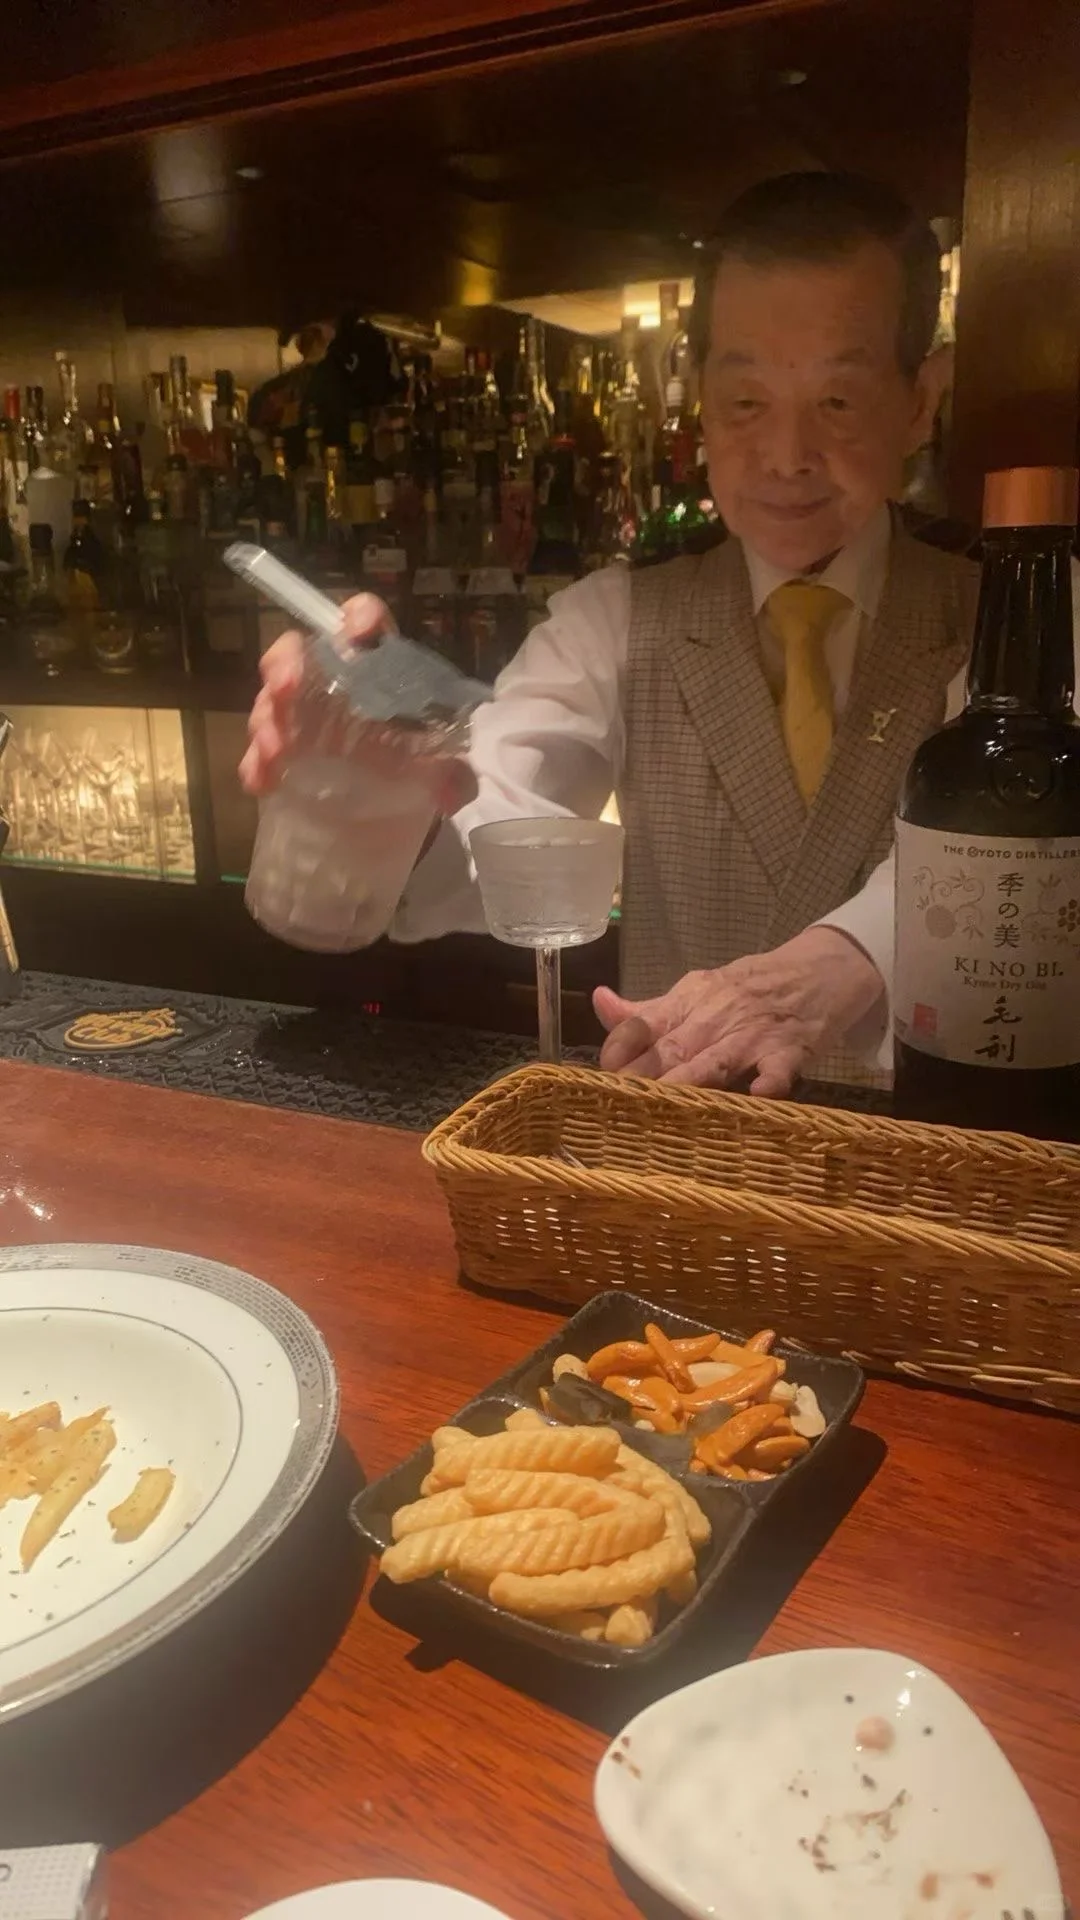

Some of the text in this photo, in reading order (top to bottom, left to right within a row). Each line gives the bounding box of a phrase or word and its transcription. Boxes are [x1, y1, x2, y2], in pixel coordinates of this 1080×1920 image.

[994, 872, 1024, 949] 季の美
[954, 955, 980, 974] KI
[989, 960, 1026, 978] NO
